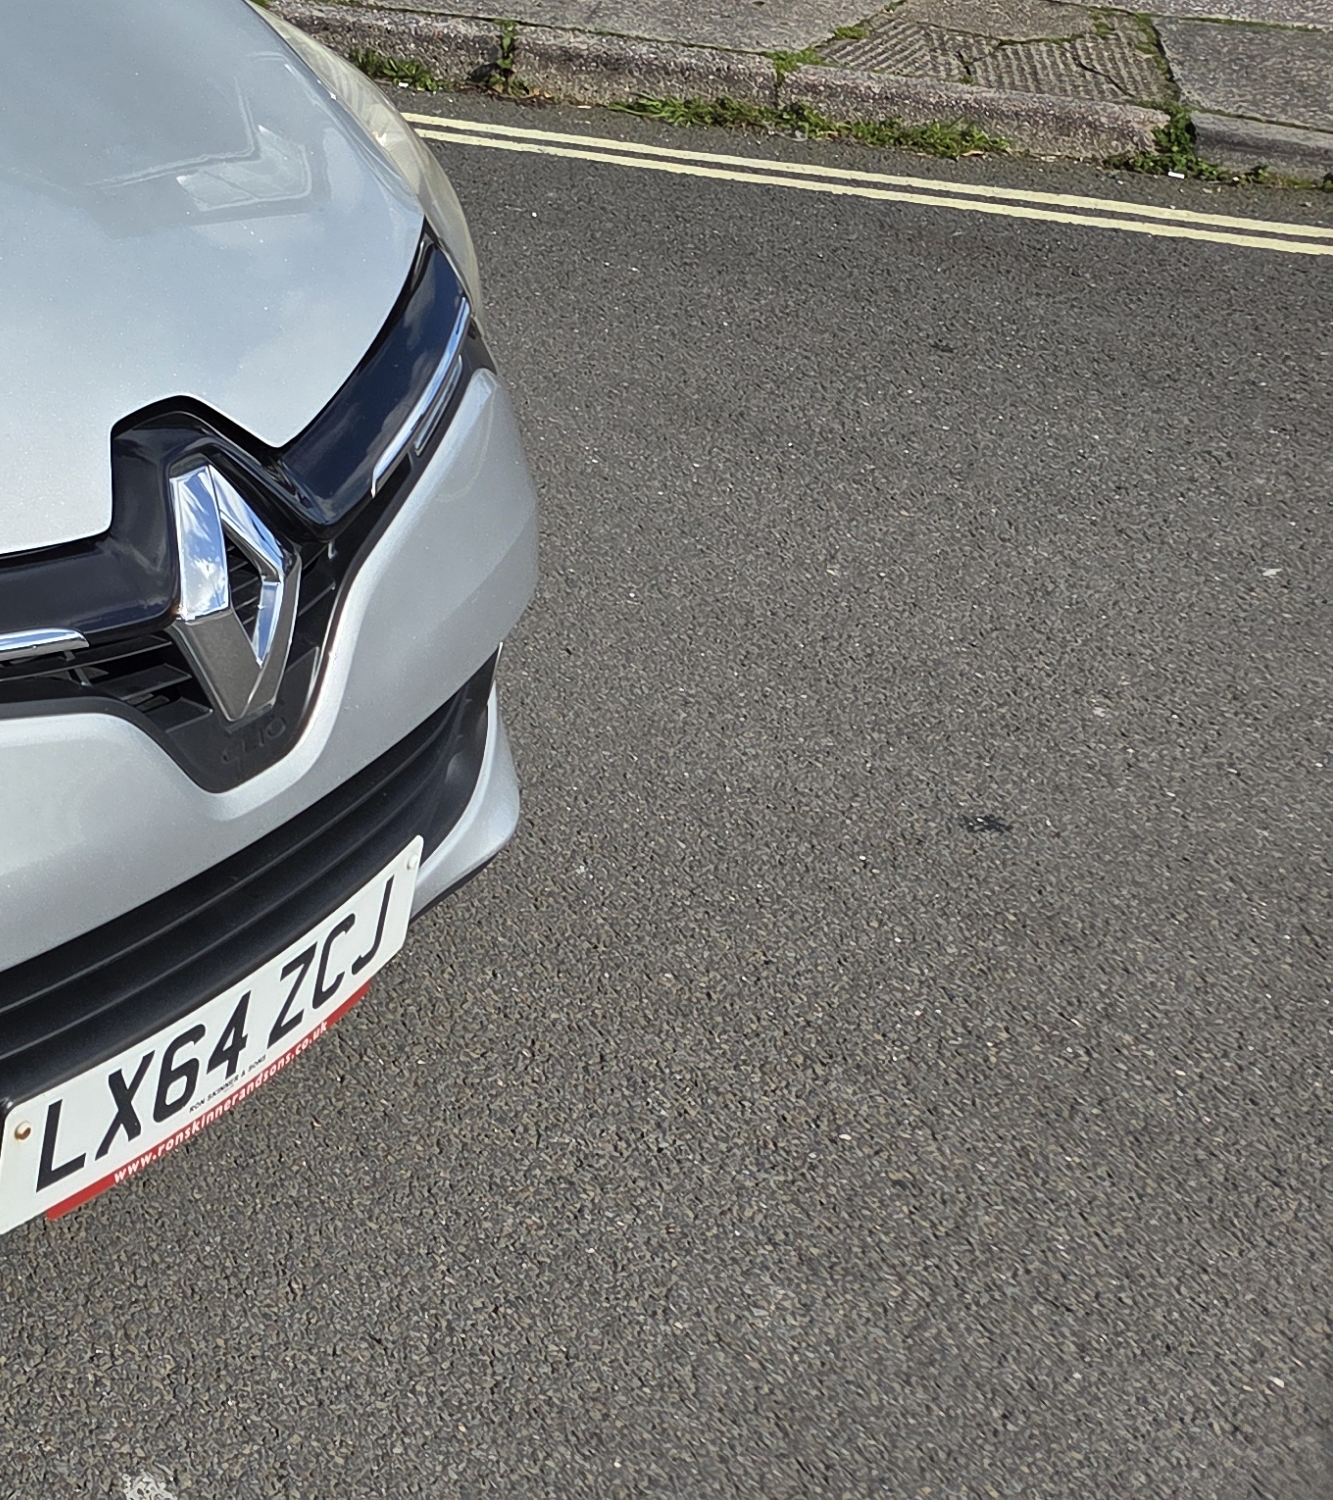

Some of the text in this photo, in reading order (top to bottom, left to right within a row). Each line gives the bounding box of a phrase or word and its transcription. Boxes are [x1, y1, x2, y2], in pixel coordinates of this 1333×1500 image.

[36, 874, 394, 1193] LX64 ZCJ
[114, 1020, 329, 1184] www.ronskinnerandsons.co.uk
